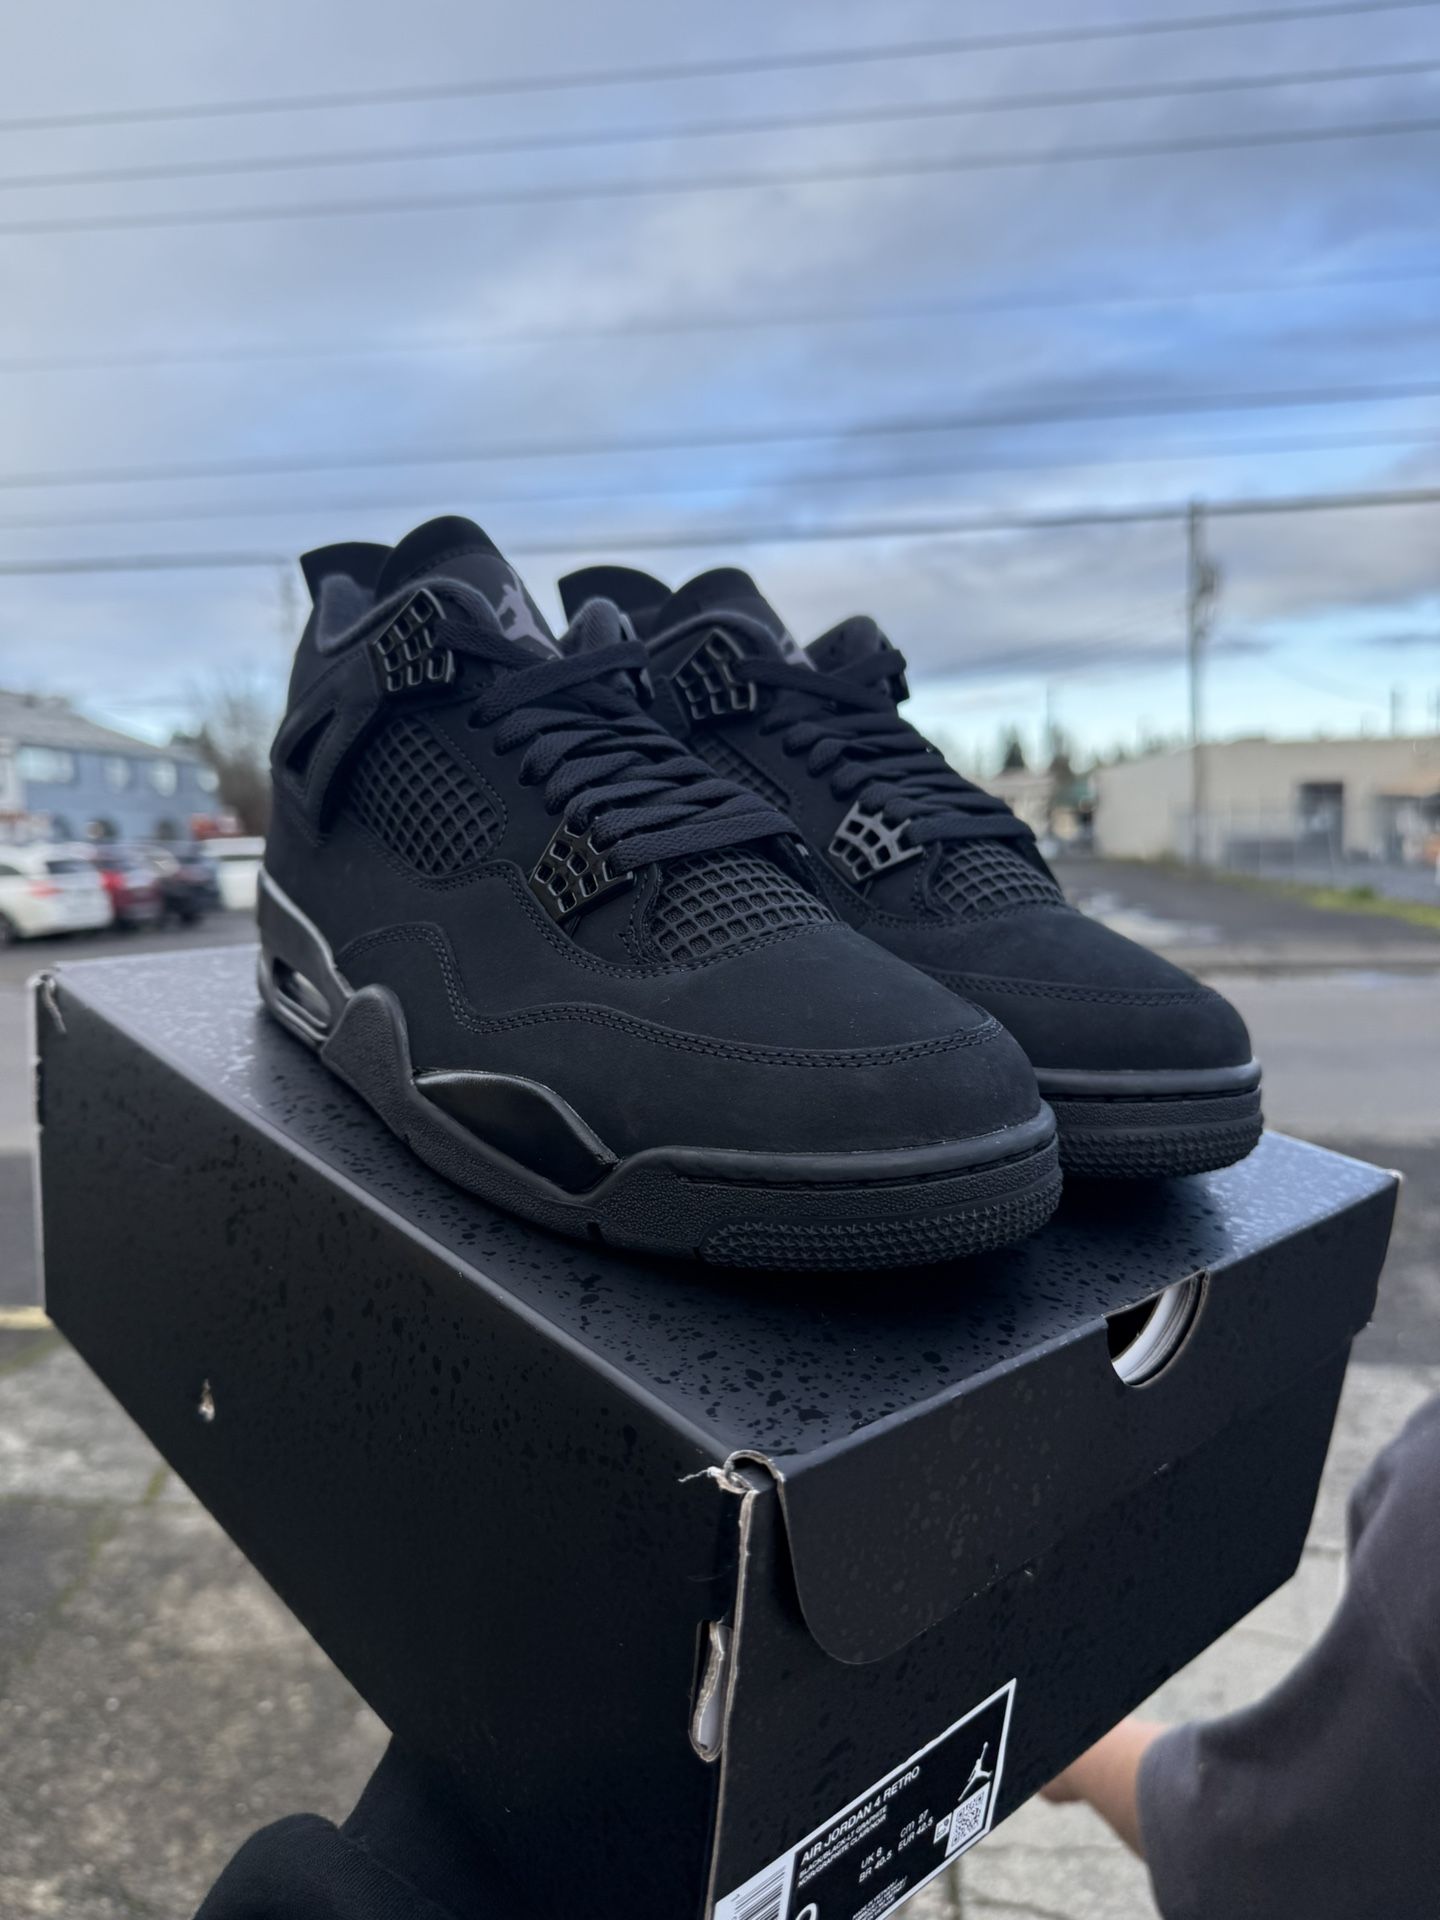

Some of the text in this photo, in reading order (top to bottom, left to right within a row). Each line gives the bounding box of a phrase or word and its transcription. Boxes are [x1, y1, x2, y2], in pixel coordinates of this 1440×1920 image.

[801, 1765, 920, 1866] AIR JORDAN 4 RETRO
[898, 1831, 915, 1851] EUR
[861, 1852, 875, 1869] UK
[859, 1866, 872, 1882] BR
